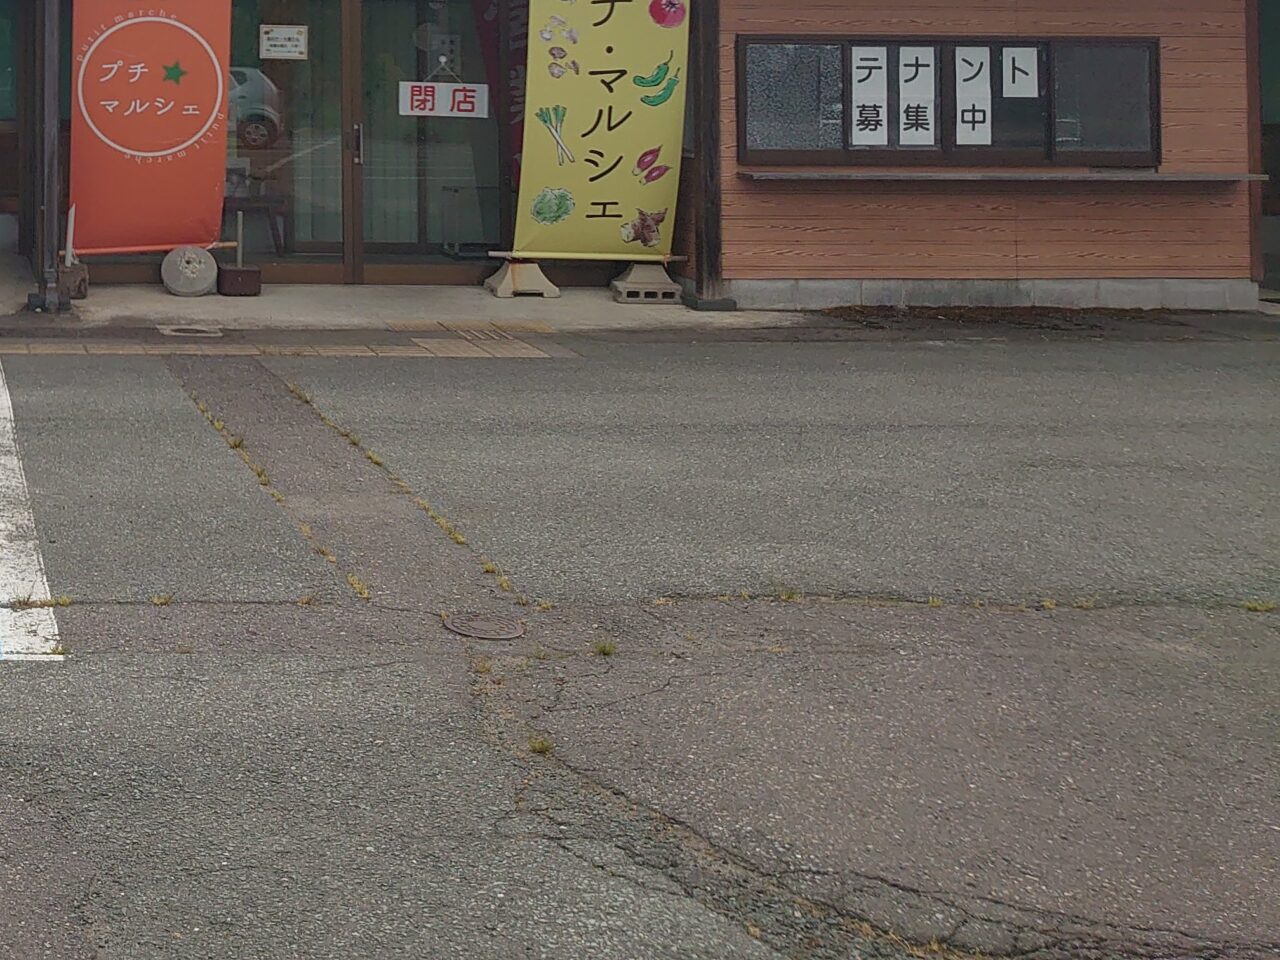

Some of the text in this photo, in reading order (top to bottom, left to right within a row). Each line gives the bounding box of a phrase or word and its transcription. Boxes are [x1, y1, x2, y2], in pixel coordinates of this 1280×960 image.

[99, 59, 149, 83] プチ
[855, 54, 1030, 84] テナント
[99, 97, 200, 117] マルシェ
[409, 85, 477, 113] 閉店
[855, 102, 987, 132] 募集中
